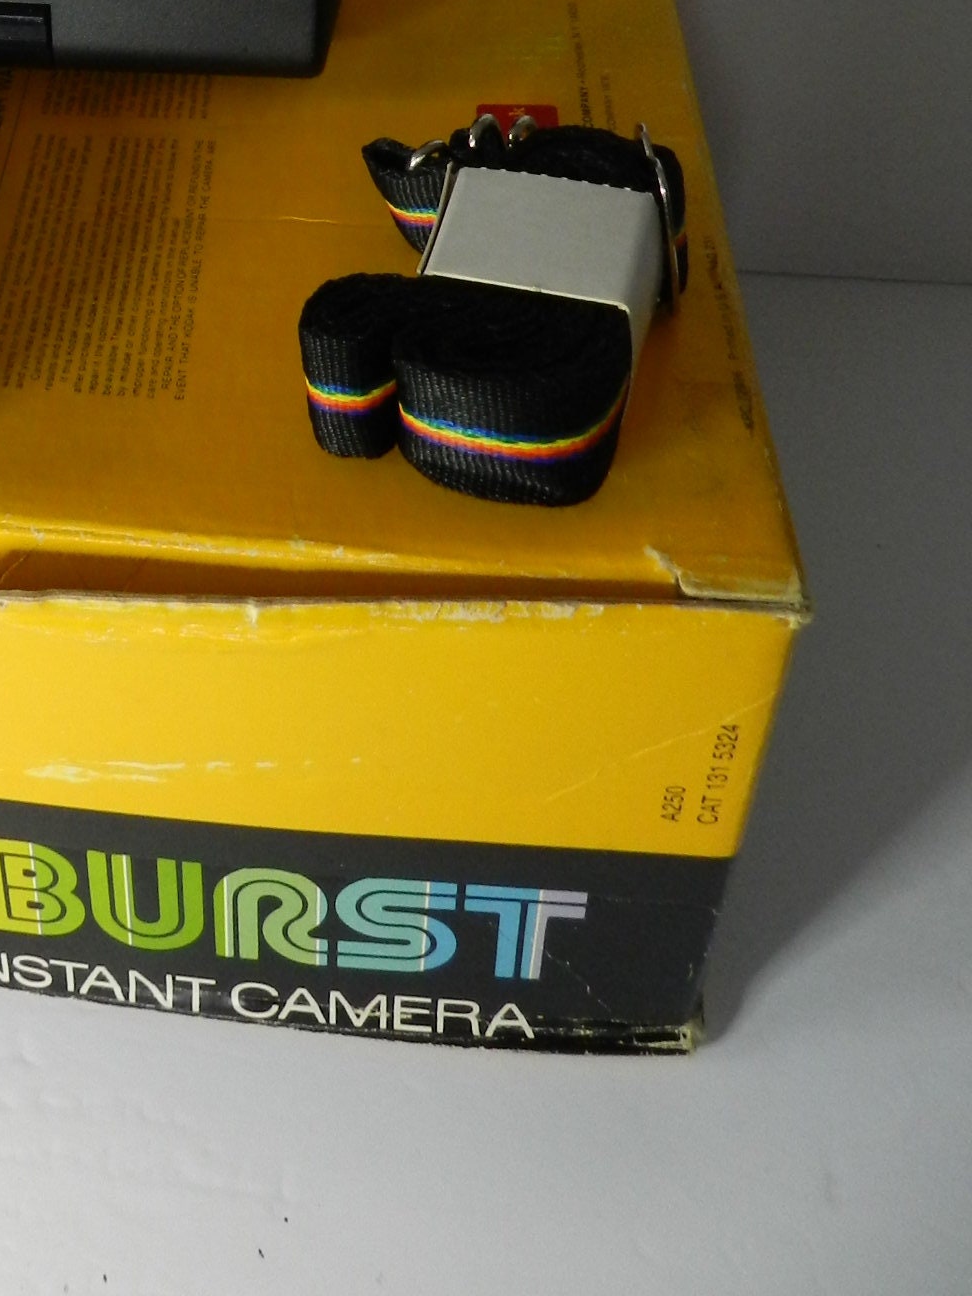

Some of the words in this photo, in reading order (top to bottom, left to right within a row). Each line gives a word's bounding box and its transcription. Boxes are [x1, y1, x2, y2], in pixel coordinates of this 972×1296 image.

[712, 724, 739, 760] 5324
[707, 766, 730, 790] 131
[661, 785, 686, 822] A250
[697, 795, 723, 825] CAT
[230, 981, 536, 1040] CAMERA
